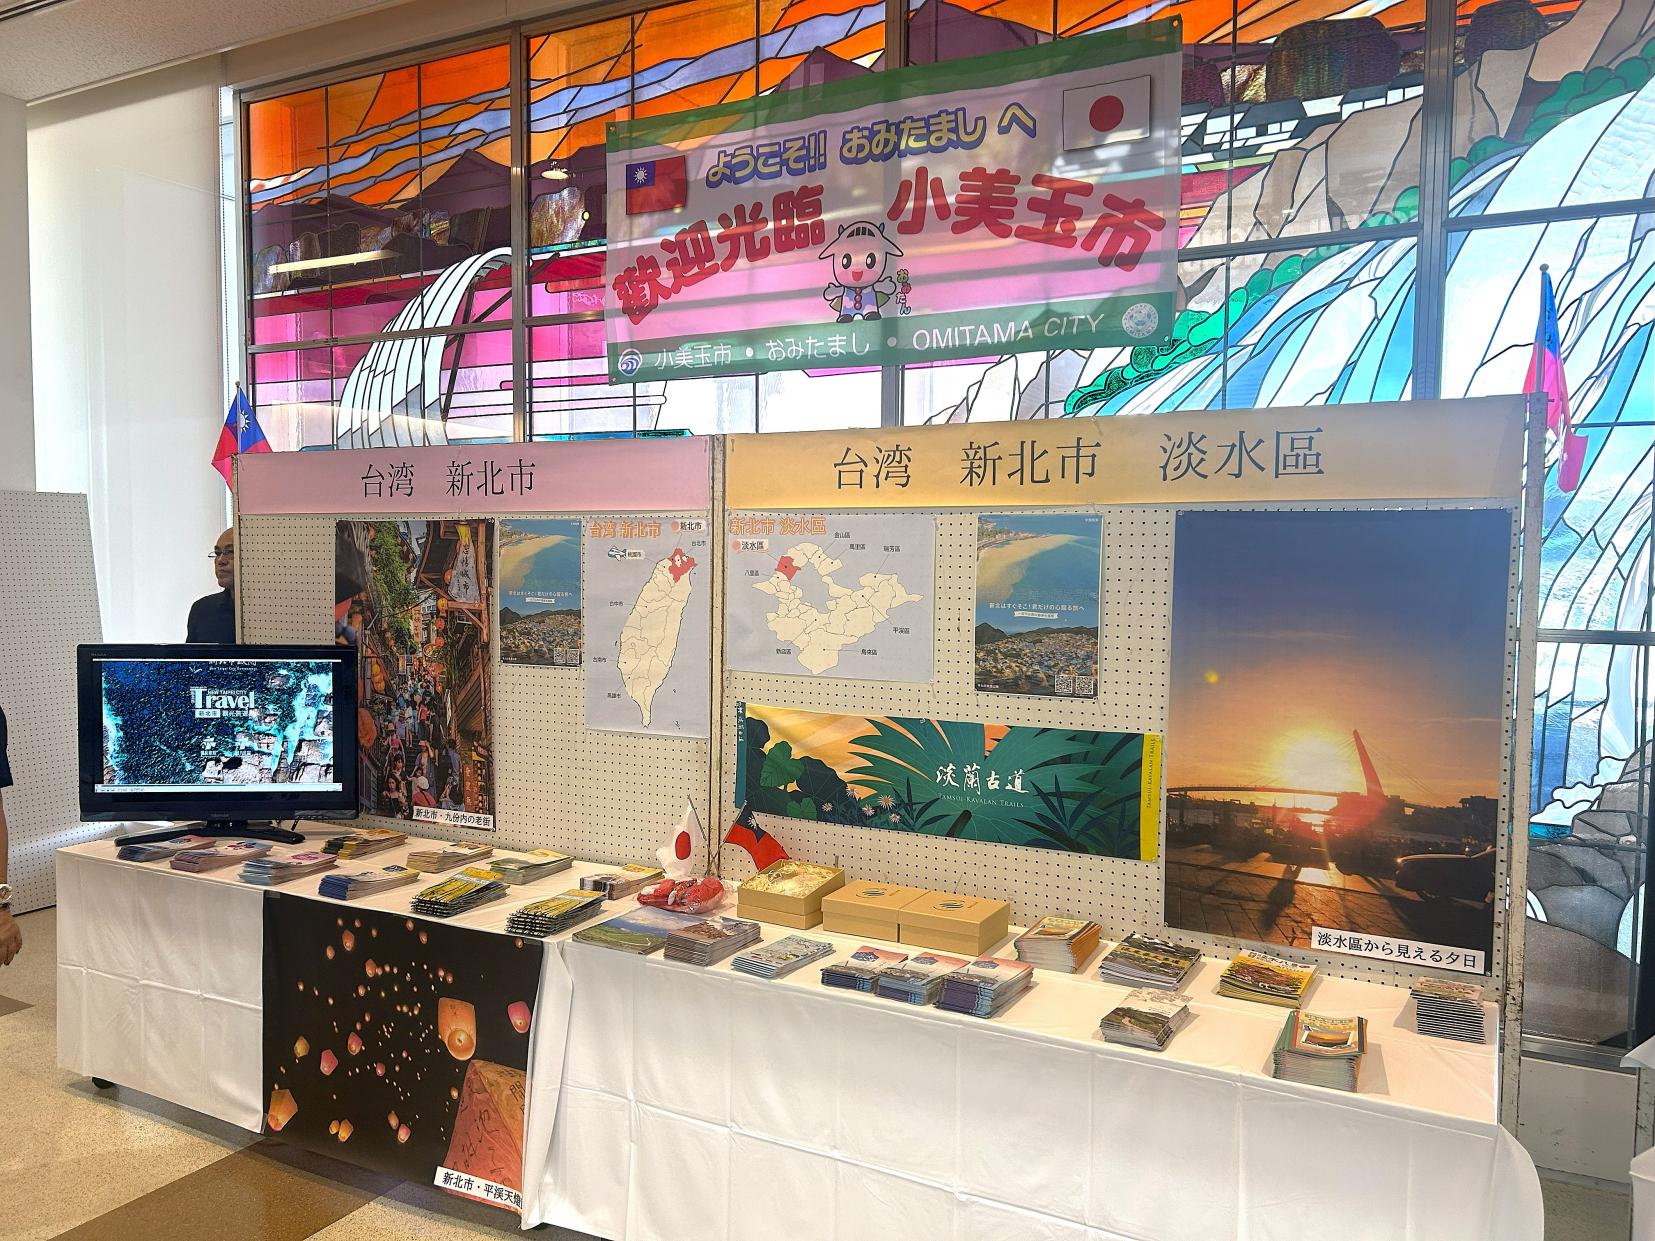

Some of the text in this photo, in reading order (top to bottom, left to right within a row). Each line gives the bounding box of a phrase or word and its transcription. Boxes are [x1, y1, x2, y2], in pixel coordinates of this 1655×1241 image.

[706, 101, 1036, 188] ようこそ!! おみたまし へ
[887, 166, 1167, 273] 小美玉市
[612, 184, 826, 325] 歡迎光臨
[912, 319, 1033, 350] OMITAMA
[1043, 313, 1105, 337] CITY
[654, 332, 870, 370] 小美玉市 おみたまし
[833, 426, 1325, 490] 台湾 新北市 淡水區
[361, 458, 536, 498] 台湾 新北市
[621, 521, 661, 538] 新北市
[680, 521, 702, 531] 新北市
[730, 518, 826, 536] 新北市 淡水區
[741, 540, 765, 551] 淡水區
[190, 687, 255, 709] Travel
[1000, 800, 1024, 808] TRAILS
[1317, 931, 1476, 969] 淡水區から見える夕日
